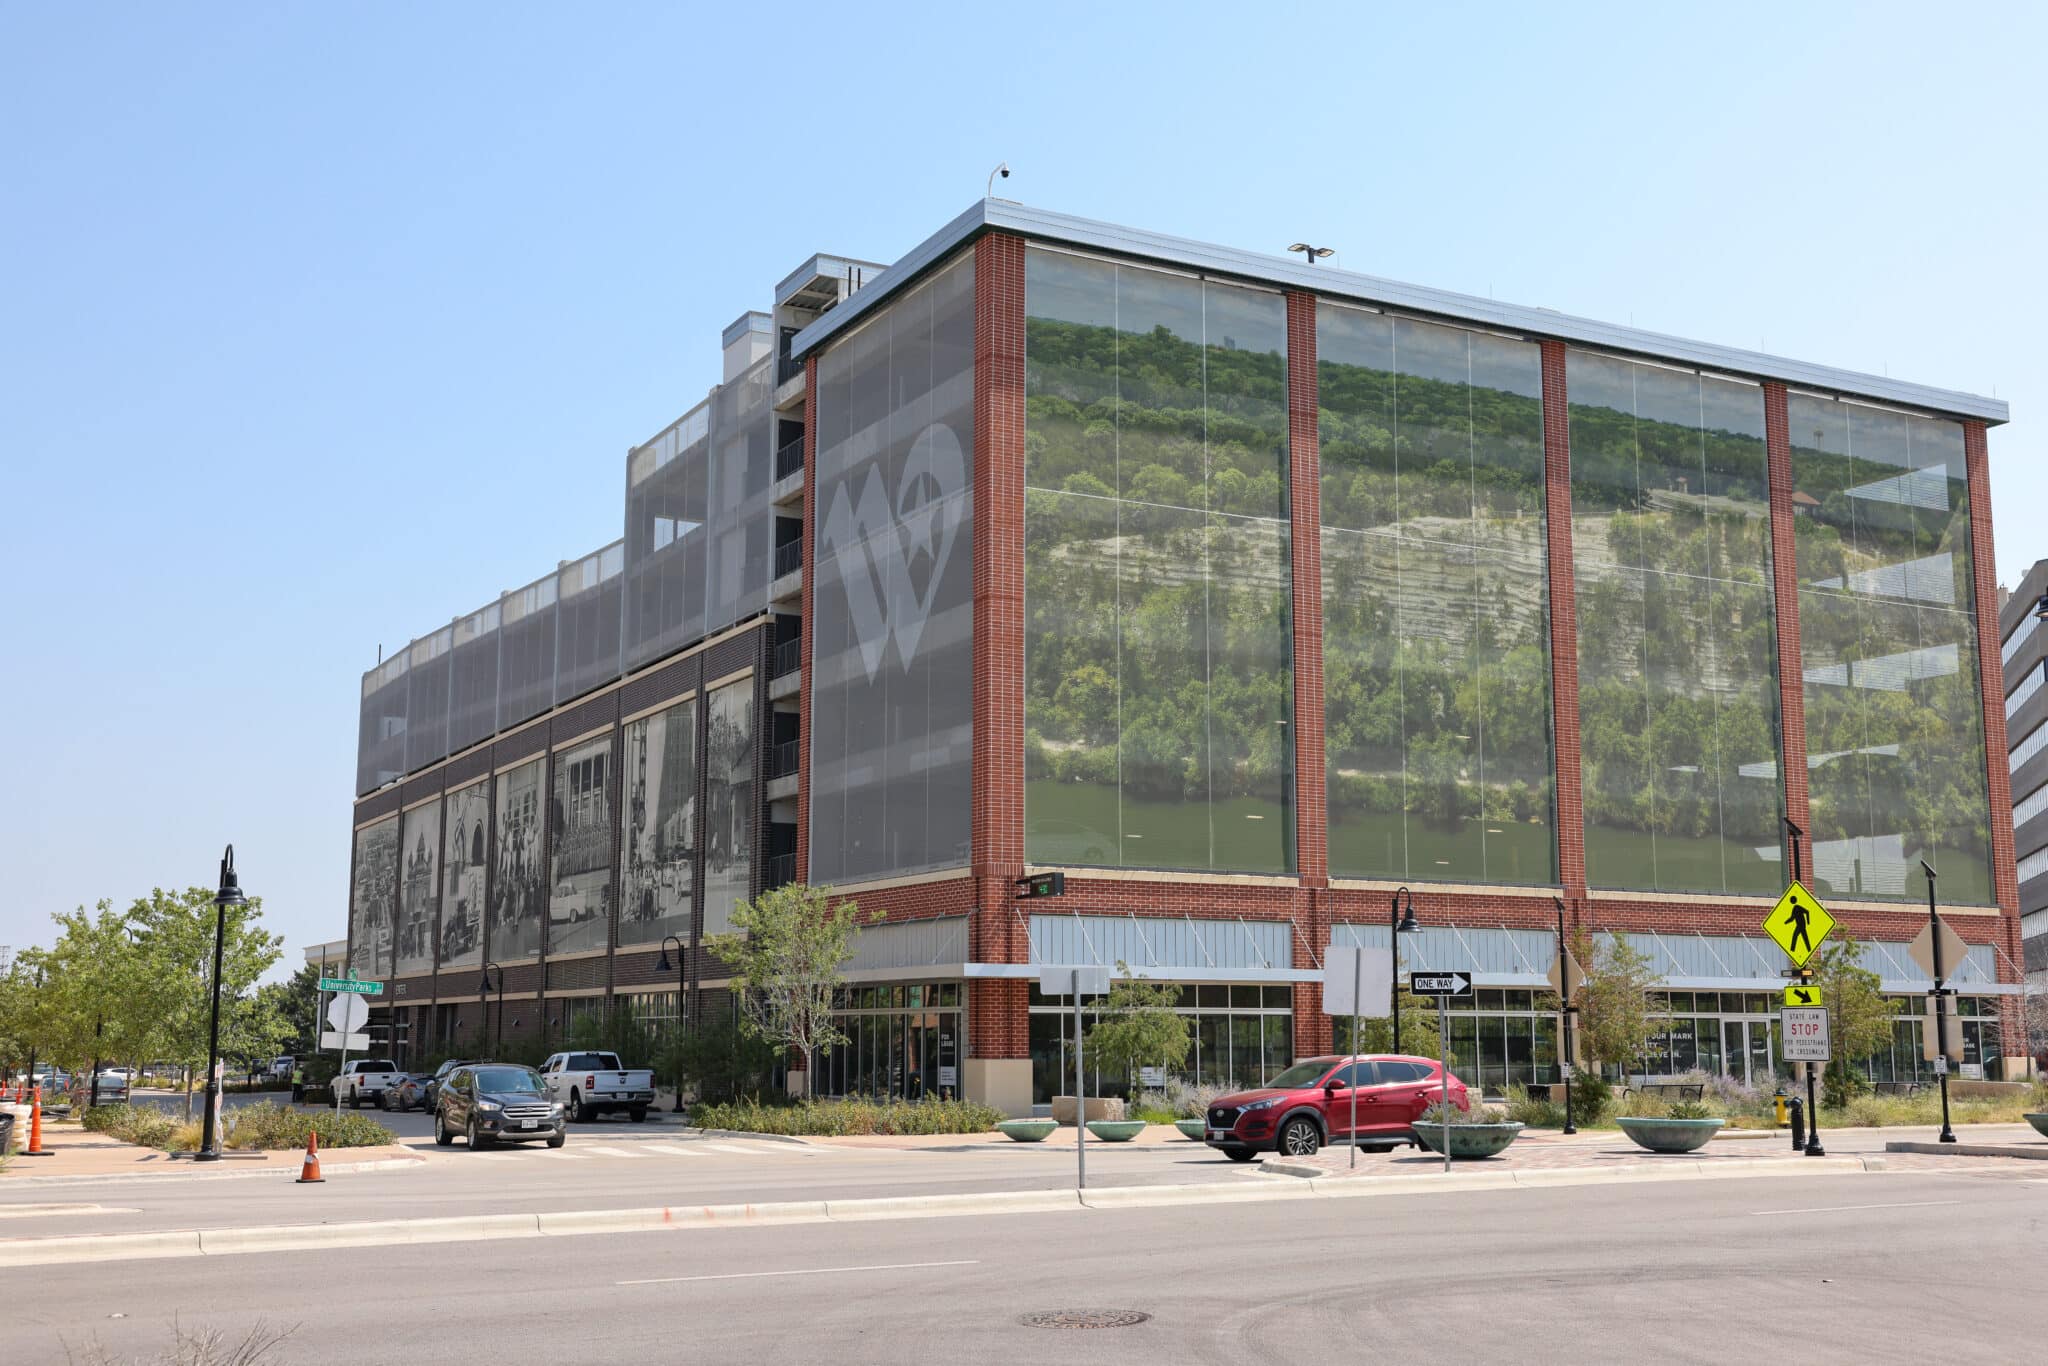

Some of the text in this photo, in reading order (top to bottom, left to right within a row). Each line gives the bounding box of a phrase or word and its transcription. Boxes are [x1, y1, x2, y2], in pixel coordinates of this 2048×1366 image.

[1417, 979, 1453, 988] ONE WAY
[1791, 1023, 1819, 1036] STOP
